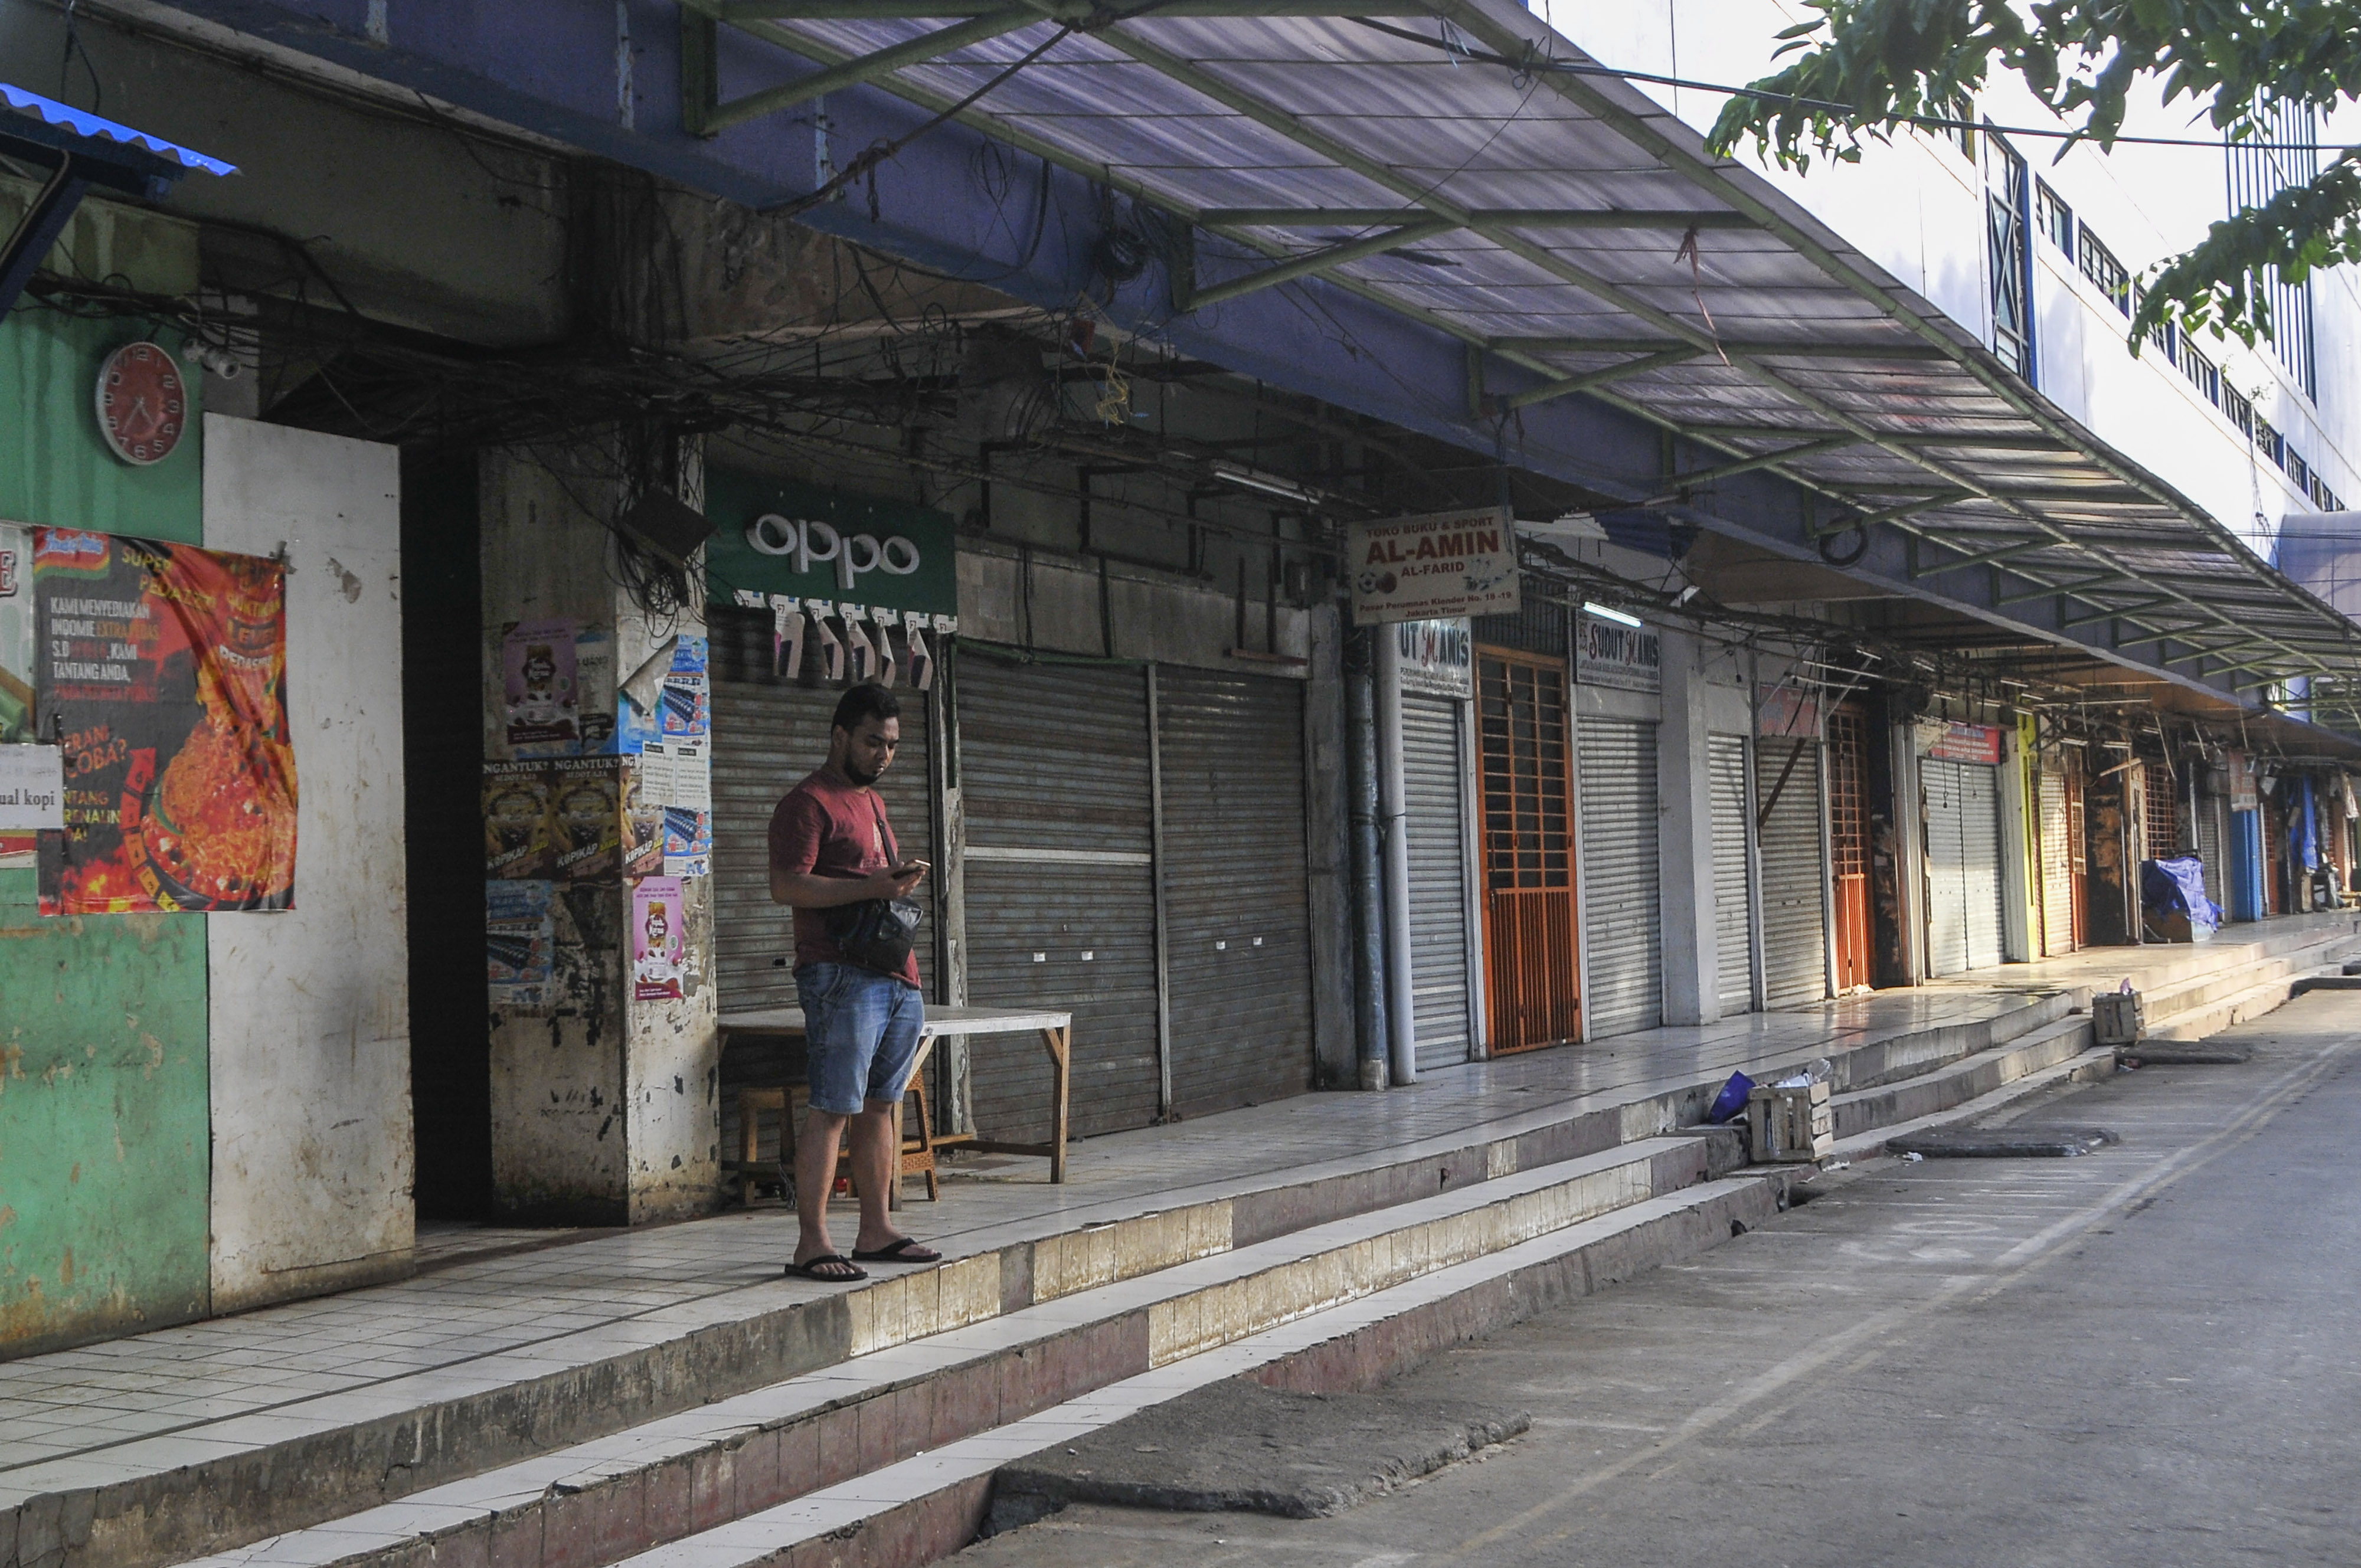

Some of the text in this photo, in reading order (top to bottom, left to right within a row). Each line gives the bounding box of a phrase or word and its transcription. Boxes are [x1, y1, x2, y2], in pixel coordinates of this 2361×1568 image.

[163, 375, 175, 388] 2
[168, 400, 179, 413] 3
[163, 423, 174, 435] 4
[134, 446, 146, 458] 6
[153, 440, 163, 453] 5
[1366, 516, 1494, 538] TOKO BUKU & SPORT
[1366, 530, 1499, 565] AL-AMIN
[122, 546, 171, 570] SUPER
[1401, 561, 1464, 577] AL-FARID
[51, 597, 149, 618] KAMI MENYEDIAKAN
[1360, 603, 1384, 612] Pasar
[1386, 600, 1428, 609] Perumnas
[1431, 597, 1465, 605] Klender
[1405, 609, 1438, 617] Jakarta
[51, 619, 94, 637] INDOMIE
[110, 643, 138, 660] KAMI
[1421, 627, 1469, 667] MANIS
[1589, 623, 1624, 662] SUDUT
[1625, 630, 1659, 667] MANIS
[53, 662, 132, 683] TANTANG ANDA,
[483, 761, 549, 774] NGANTUK?
[554, 758, 619, 771] NGANTUK?
[24, 788, 55, 811] kopi
[557, 843, 599, 869] KOPIKAP
[626, 840, 653, 865] KOPIKAP
